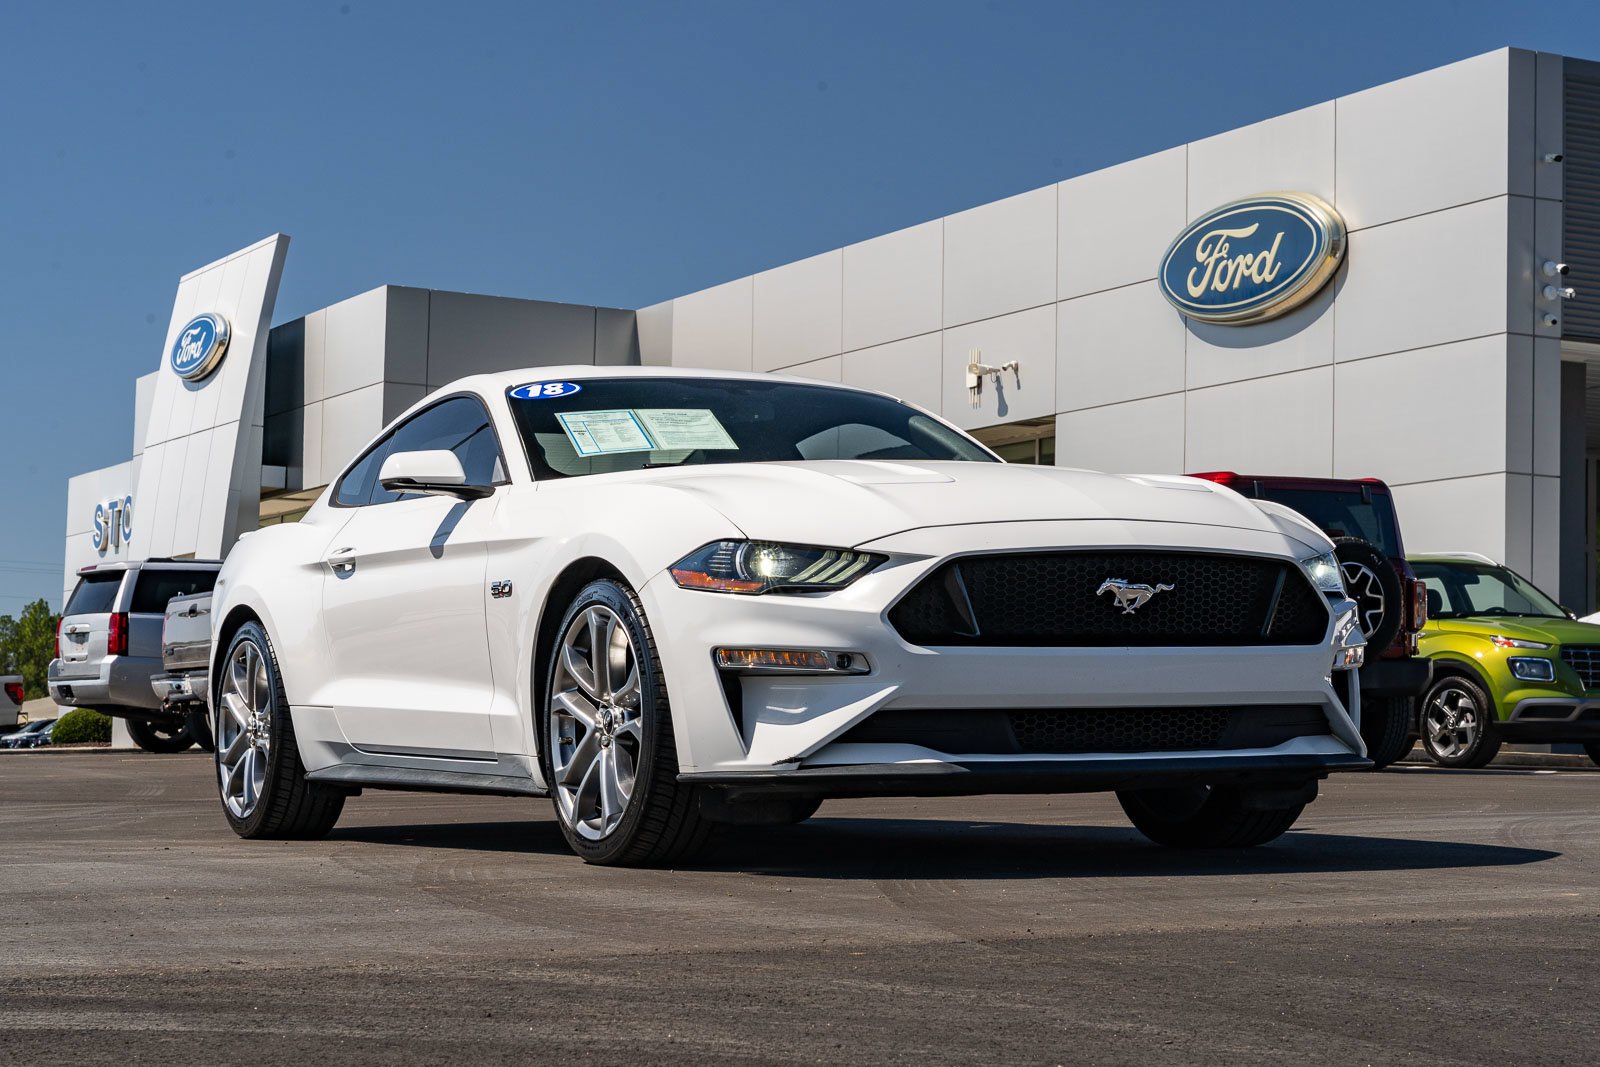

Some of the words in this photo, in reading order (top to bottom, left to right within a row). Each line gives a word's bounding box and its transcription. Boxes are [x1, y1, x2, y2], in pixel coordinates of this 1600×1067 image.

[1187, 223, 1285, 298] Ford
[176, 327, 206, 365] Ford
[526, 383, 564, 398] 18
